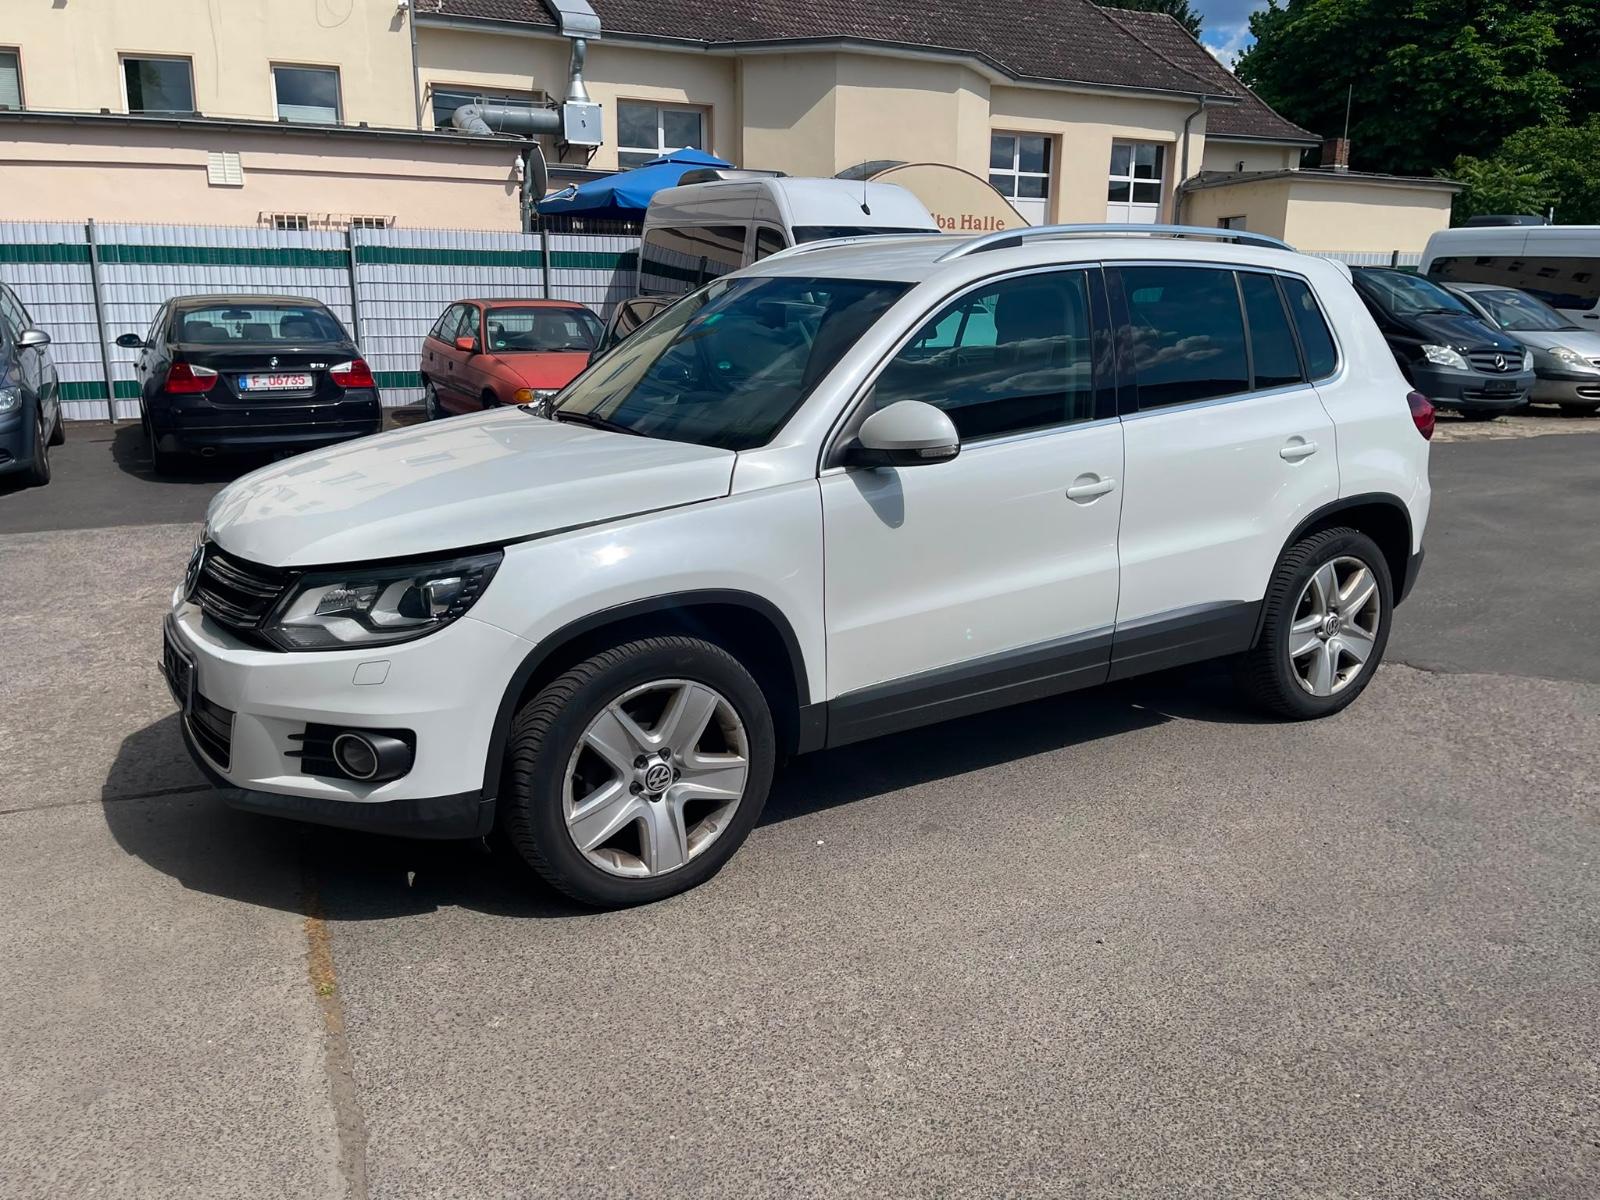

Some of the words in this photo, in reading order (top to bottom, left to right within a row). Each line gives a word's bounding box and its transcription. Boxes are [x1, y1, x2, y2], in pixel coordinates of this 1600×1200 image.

[930, 213, 956, 230] ba
[960, 214, 1005, 231] Halle
[268, 374, 306, 386] 06735
